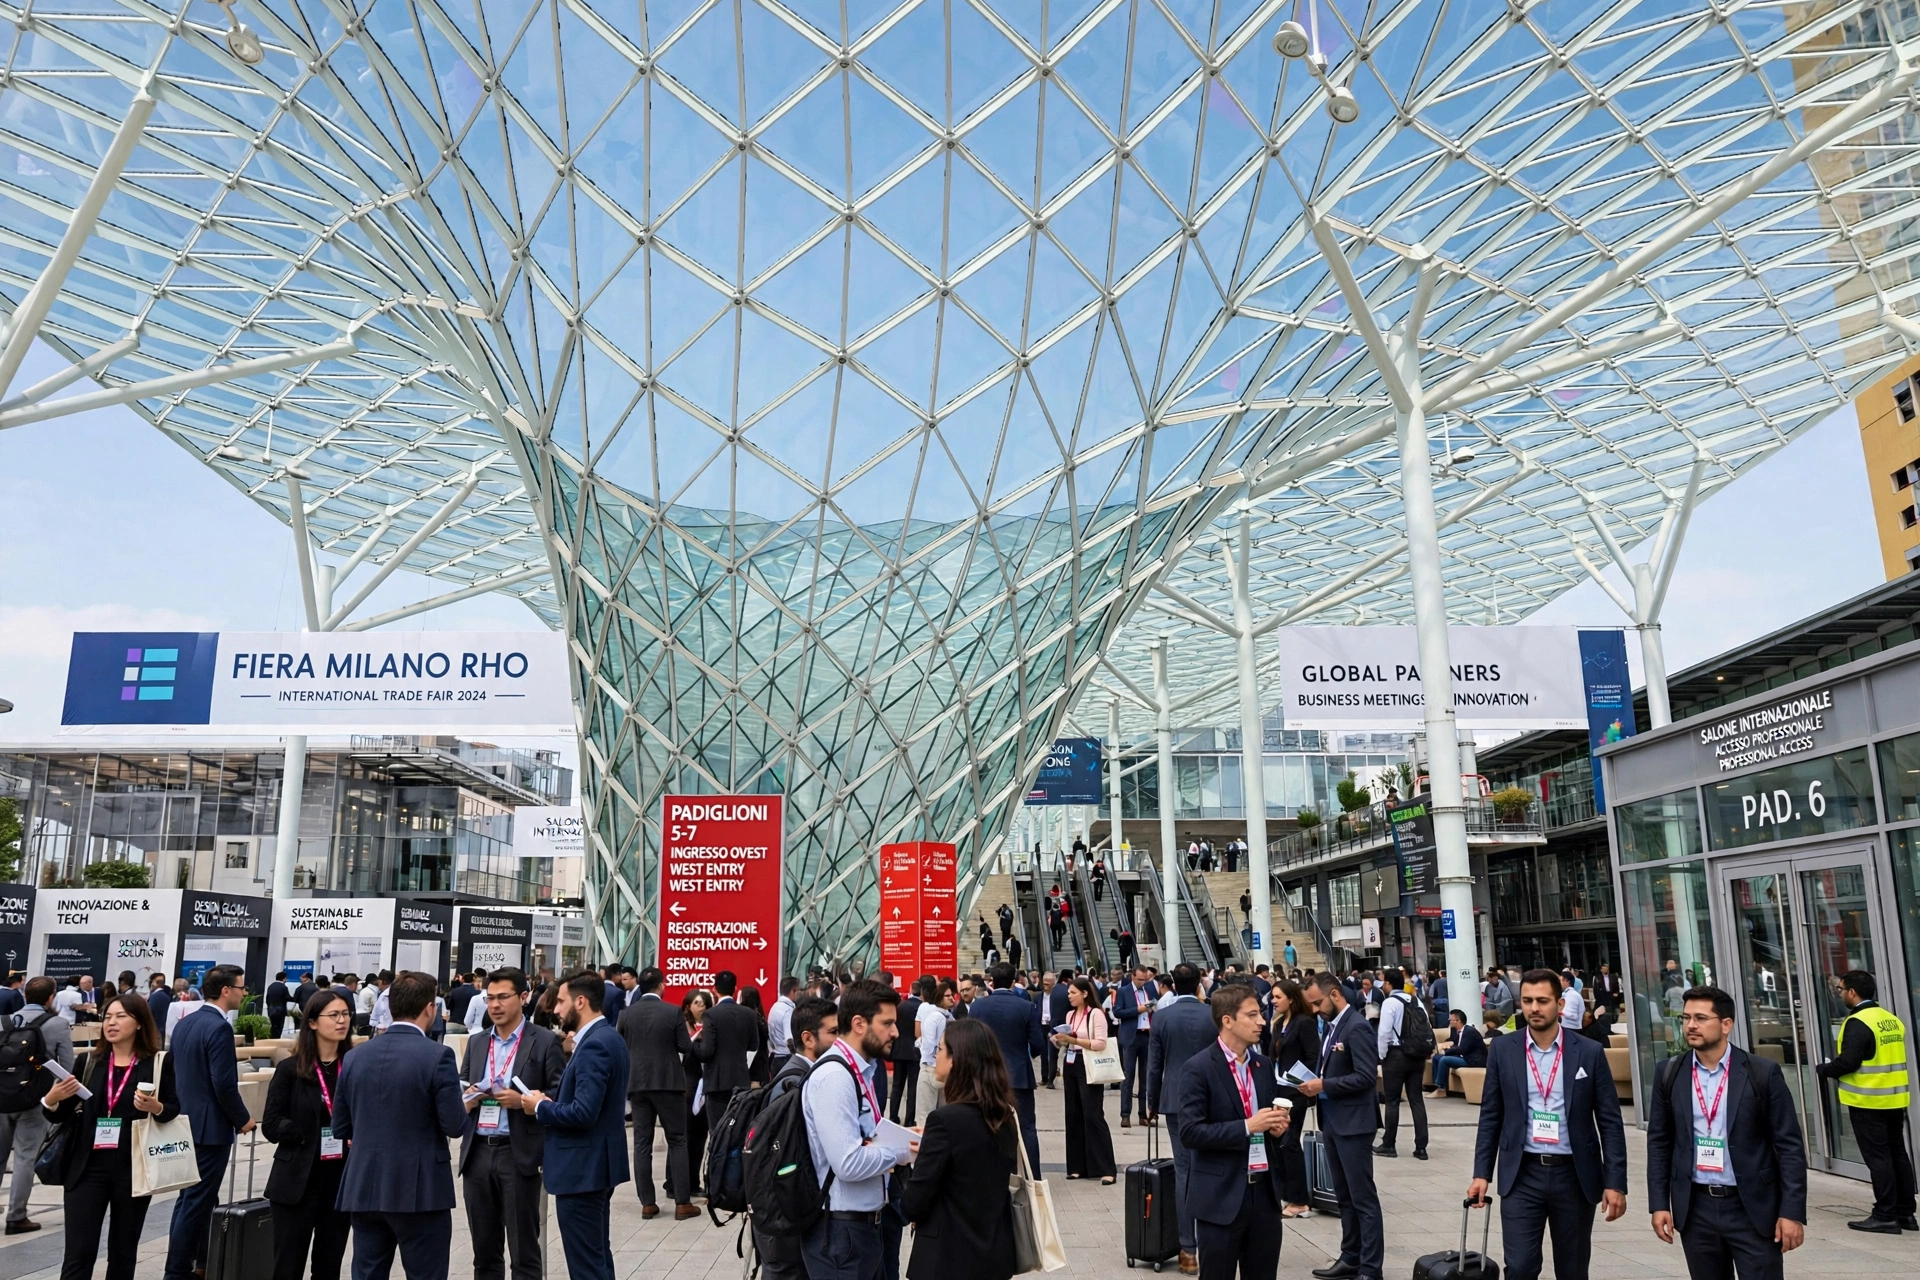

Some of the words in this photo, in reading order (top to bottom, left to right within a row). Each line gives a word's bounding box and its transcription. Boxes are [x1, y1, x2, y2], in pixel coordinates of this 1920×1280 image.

[233, 653, 315, 679] FIERA
[325, 652, 450, 679] MILANO
[461, 652, 529, 679] RHO
[1302, 665, 1388, 682] GLOBAL
[1395, 664, 1501, 682] PANERS
[278, 690, 378, 701] INTERNATIONAL
[383, 690, 423, 701] TRADE
[427, 690, 454, 701] FAIR
[457, 690, 487, 701] 2024
[1298, 694, 1360, 706] BUSINESS
[1453, 693, 1529, 706] INNOVATION
[1701, 719, 1738, 745] SALONE
[1739, 690, 1832, 733] INTERNAZIONALE
[1752, 714, 1824, 747] PROFESSIONALE
[1779, 735, 1814, 755] ACCESS
[1741, 789, 1801, 830] PAD.
[1808, 780, 1826, 818] 6
[671, 804, 768, 821] PADIGLIONI
[670, 825, 698, 841] 5-7
[670, 846, 729, 859] INGRESSO
[730, 846, 768, 859] OVEST
[669, 862, 704, 876] WEST
[705, 862, 746, 876] ENTRY
[669, 879, 704, 892] WEST
[705, 879, 745, 892] ENTRY
[57, 899, 138, 911] INNOVAZIONE
[141, 899, 151, 911] &
[57, 913, 89, 925] TECH
[291, 908, 364, 918] SUSTAINABLE
[290, 920, 349, 930] MATERIALS
[668, 921, 758, 934] REGISTRAZIONE
[667, 937, 749, 950] REGISTRATION
[666, 957, 709, 970] SERVIZI
[665, 973, 716, 986] SERVICES
